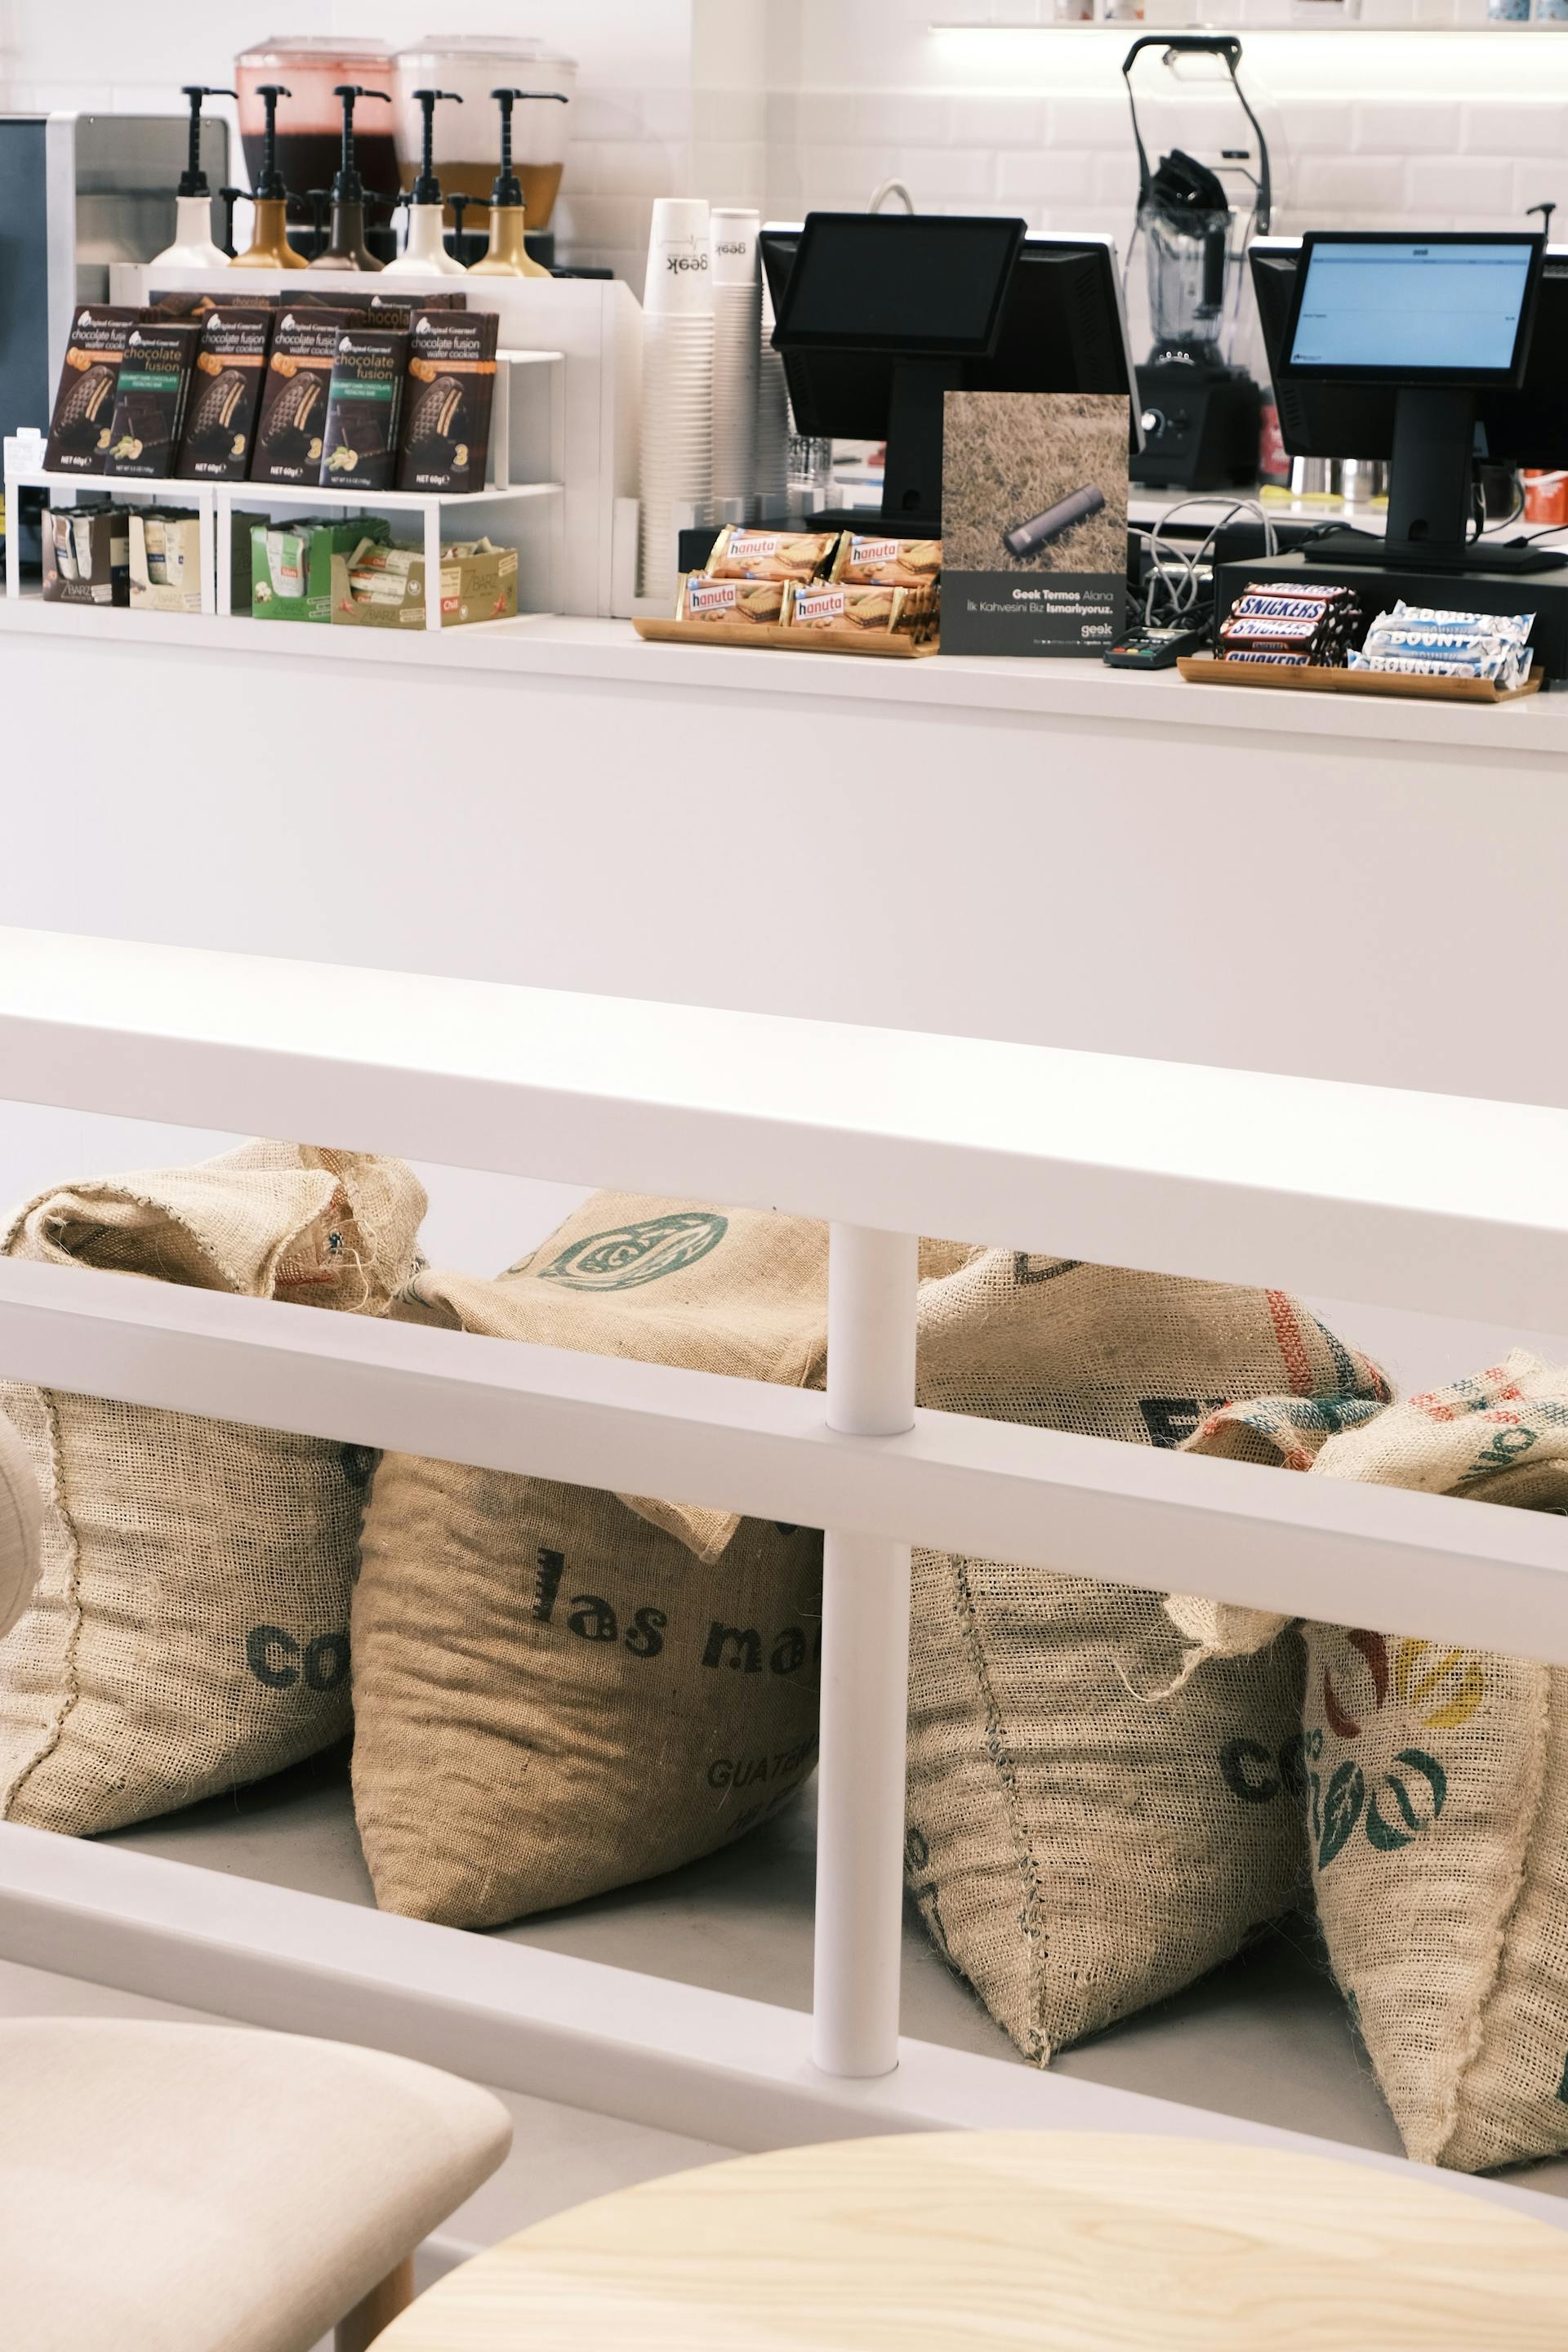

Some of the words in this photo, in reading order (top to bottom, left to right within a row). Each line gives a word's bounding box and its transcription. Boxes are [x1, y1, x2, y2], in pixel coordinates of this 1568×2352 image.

[72, 328, 110, 342] chocolate
[240, 332, 265, 345] fusion
[275, 333, 315, 346] chocolate
[412, 338, 452, 350] chocolate
[453, 336, 480, 350] fusion
[124, 346, 181, 361] chocolate
[426, 350, 448, 359] wafer
[449, 350, 479, 359] cookies
[145, 359, 180, 372] fusion
[335, 354, 394, 367] chocolate
[357, 368, 393, 381] fusion
[231, 434, 245, 455] 3
[307, 438, 323, 459] 3
[60, 455, 73, 464] NET
[453, 443, 468, 466] 3
[195, 463, 207, 471] NET
[270, 466, 283, 475] NET
[416, 474, 429, 483] NET
[730, 541, 775, 555] hanuta
[853, 545, 897, 561] hanuta
[693, 589, 735, 608] hanuta
[1012, 589, 1040, 600] Geek
[1042, 589, 1080, 601] Termos
[1083, 590, 1114, 601] Alana
[443, 598, 458, 611] Chill
[799, 597, 842, 616] hanuta
[979, 601, 1027, 612] Kahvesini
[1029, 602, 1045, 612] Biz
[1239, 597, 1324, 619] SNICKERS
[1081, 622, 1112, 638] geek
[532, 1547, 668, 1658] las
